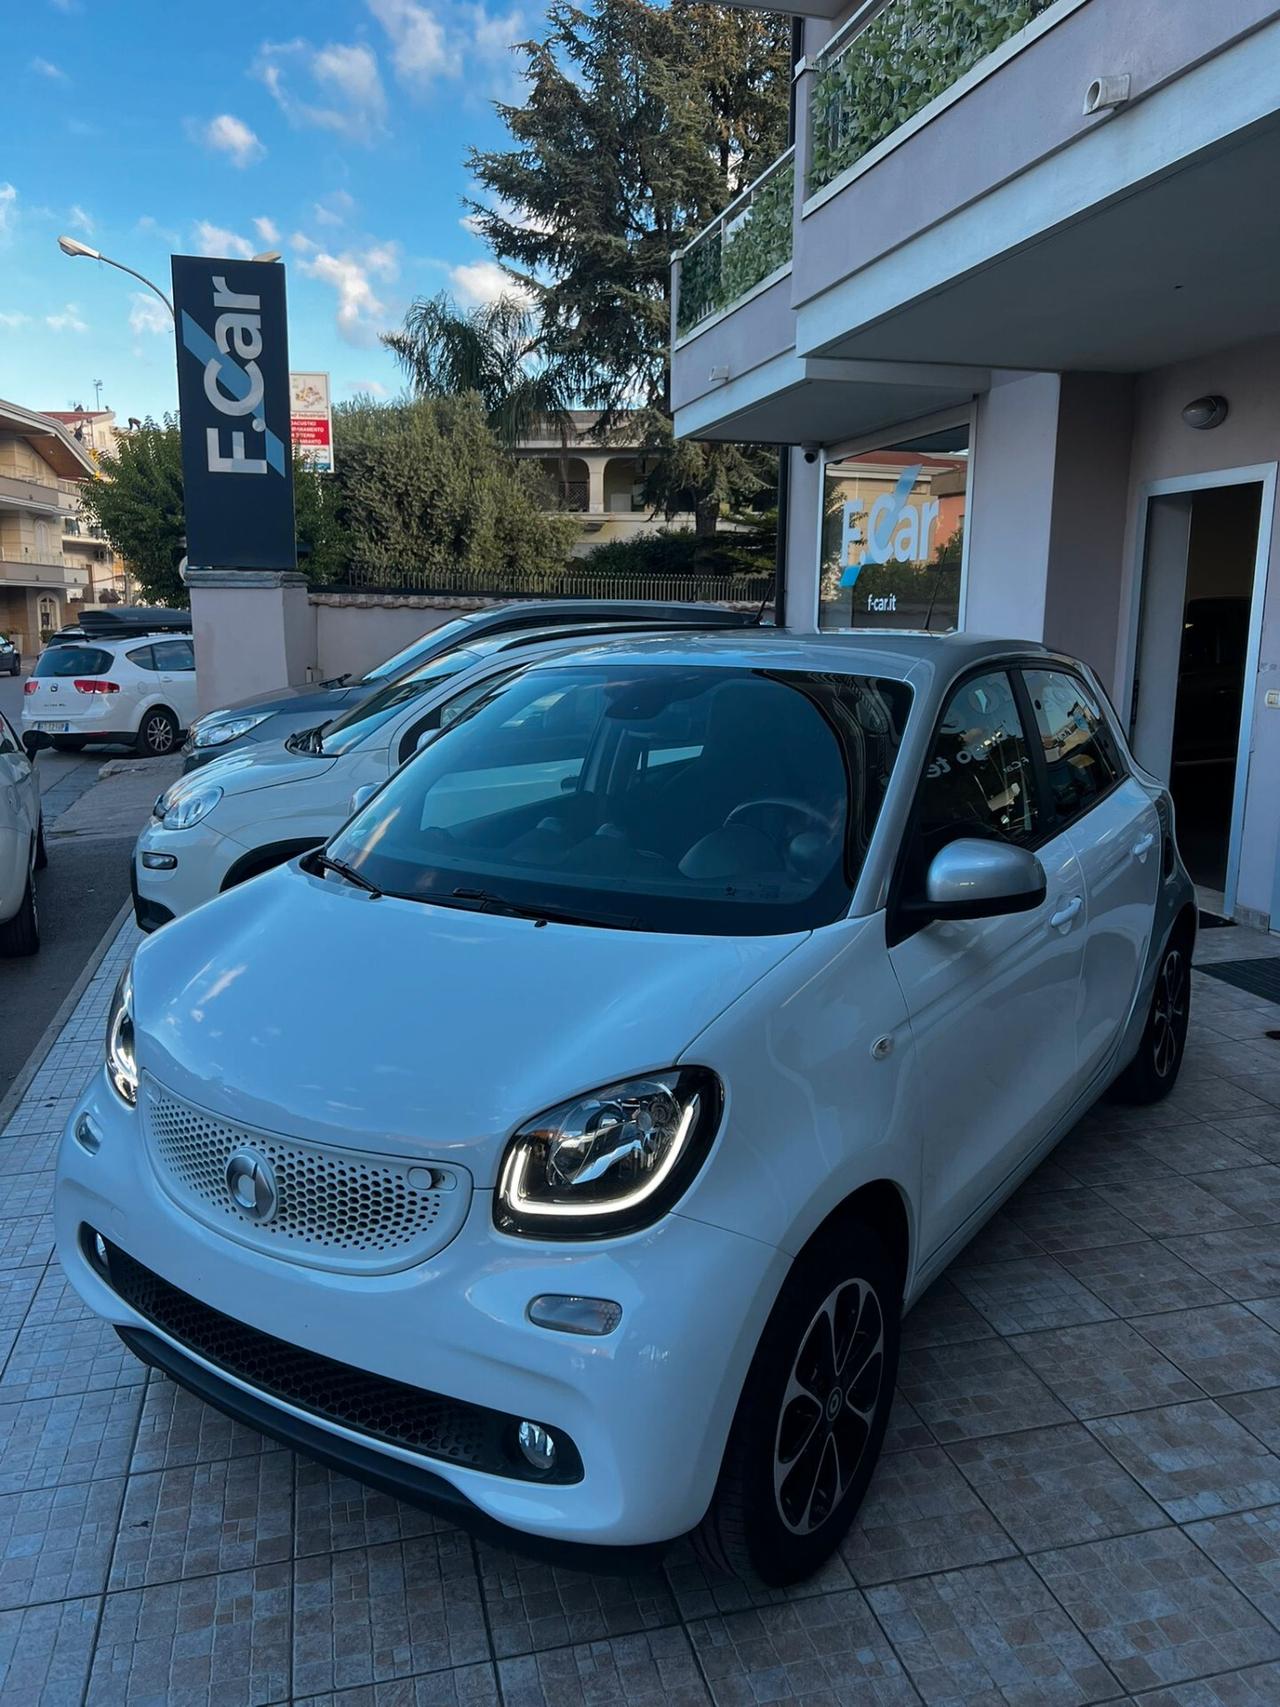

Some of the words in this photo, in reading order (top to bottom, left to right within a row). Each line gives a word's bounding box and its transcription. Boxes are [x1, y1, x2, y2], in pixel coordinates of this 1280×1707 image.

[204, 276, 268, 475] F.Car
[840, 493, 940, 567] F.Car
[867, 593, 897, 612] f-car.it
